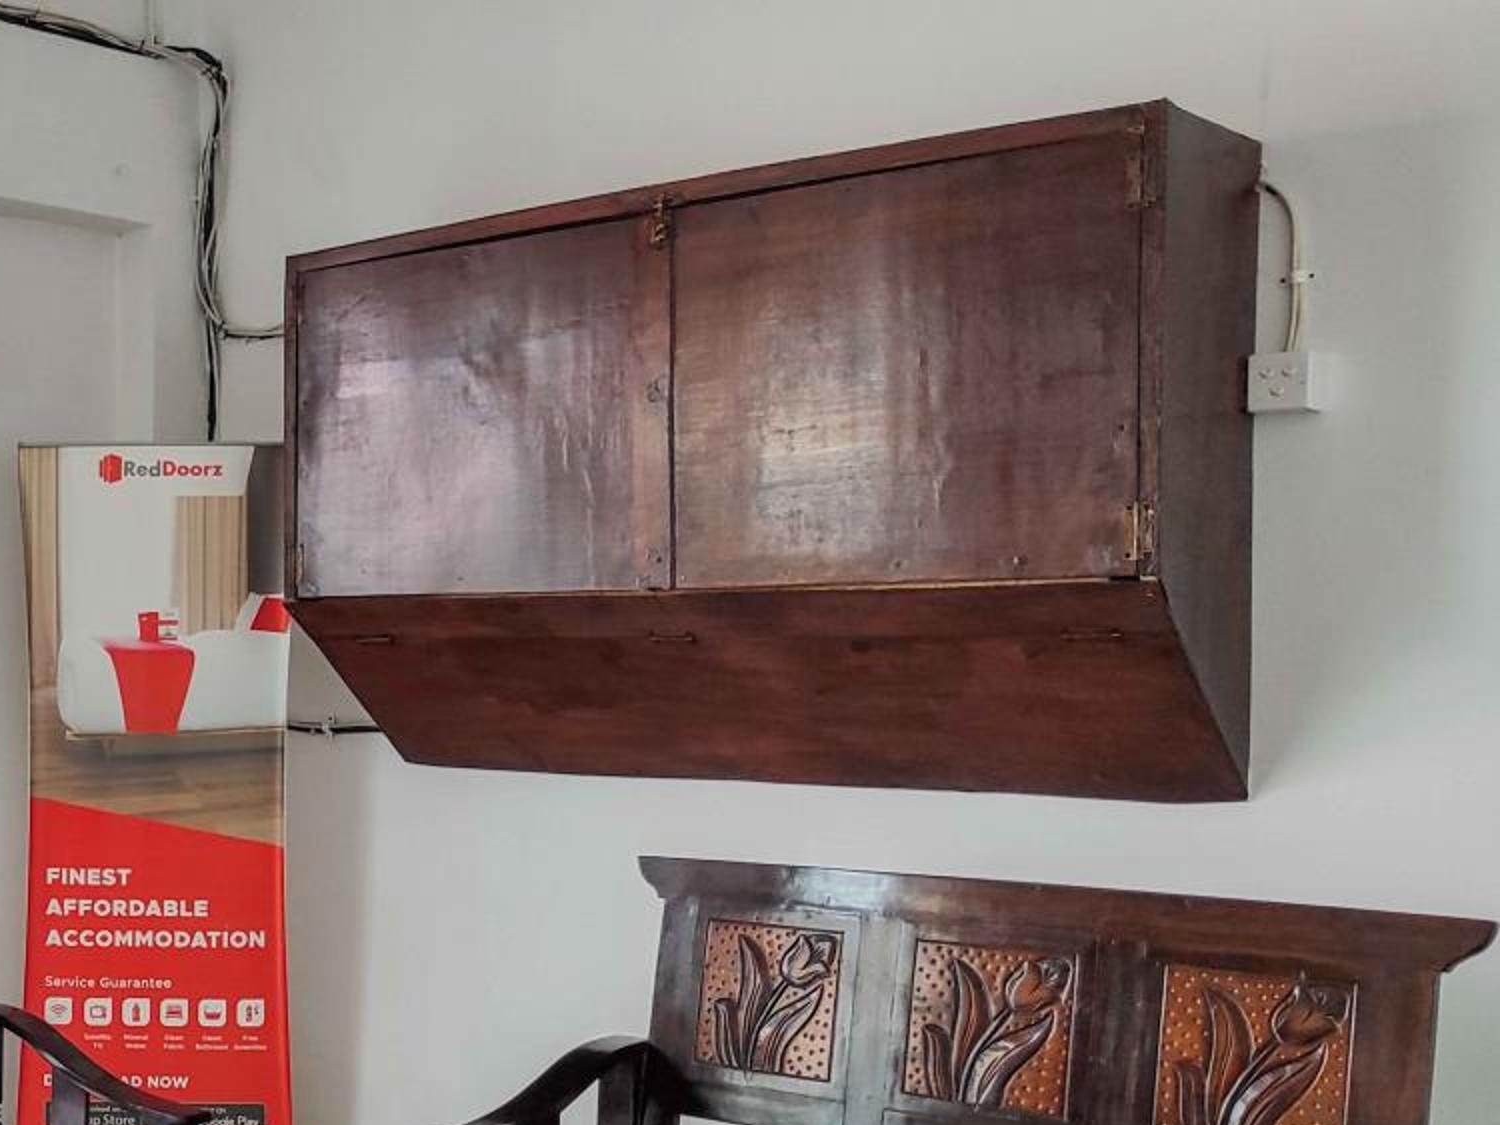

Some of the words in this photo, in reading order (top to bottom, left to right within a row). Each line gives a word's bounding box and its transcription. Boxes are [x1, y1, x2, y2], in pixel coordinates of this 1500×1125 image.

[123, 459, 223, 477] RedDoorz
[45, 867, 132, 886] FINEST
[45, 898, 209, 917] AFFORDABLE
[45, 929, 266, 949] ACCOMMODATION
[44, 975, 95, 989] Service
[99, 976, 173, 990] Guarantee
[146, 1075, 190, 1089] NOW
